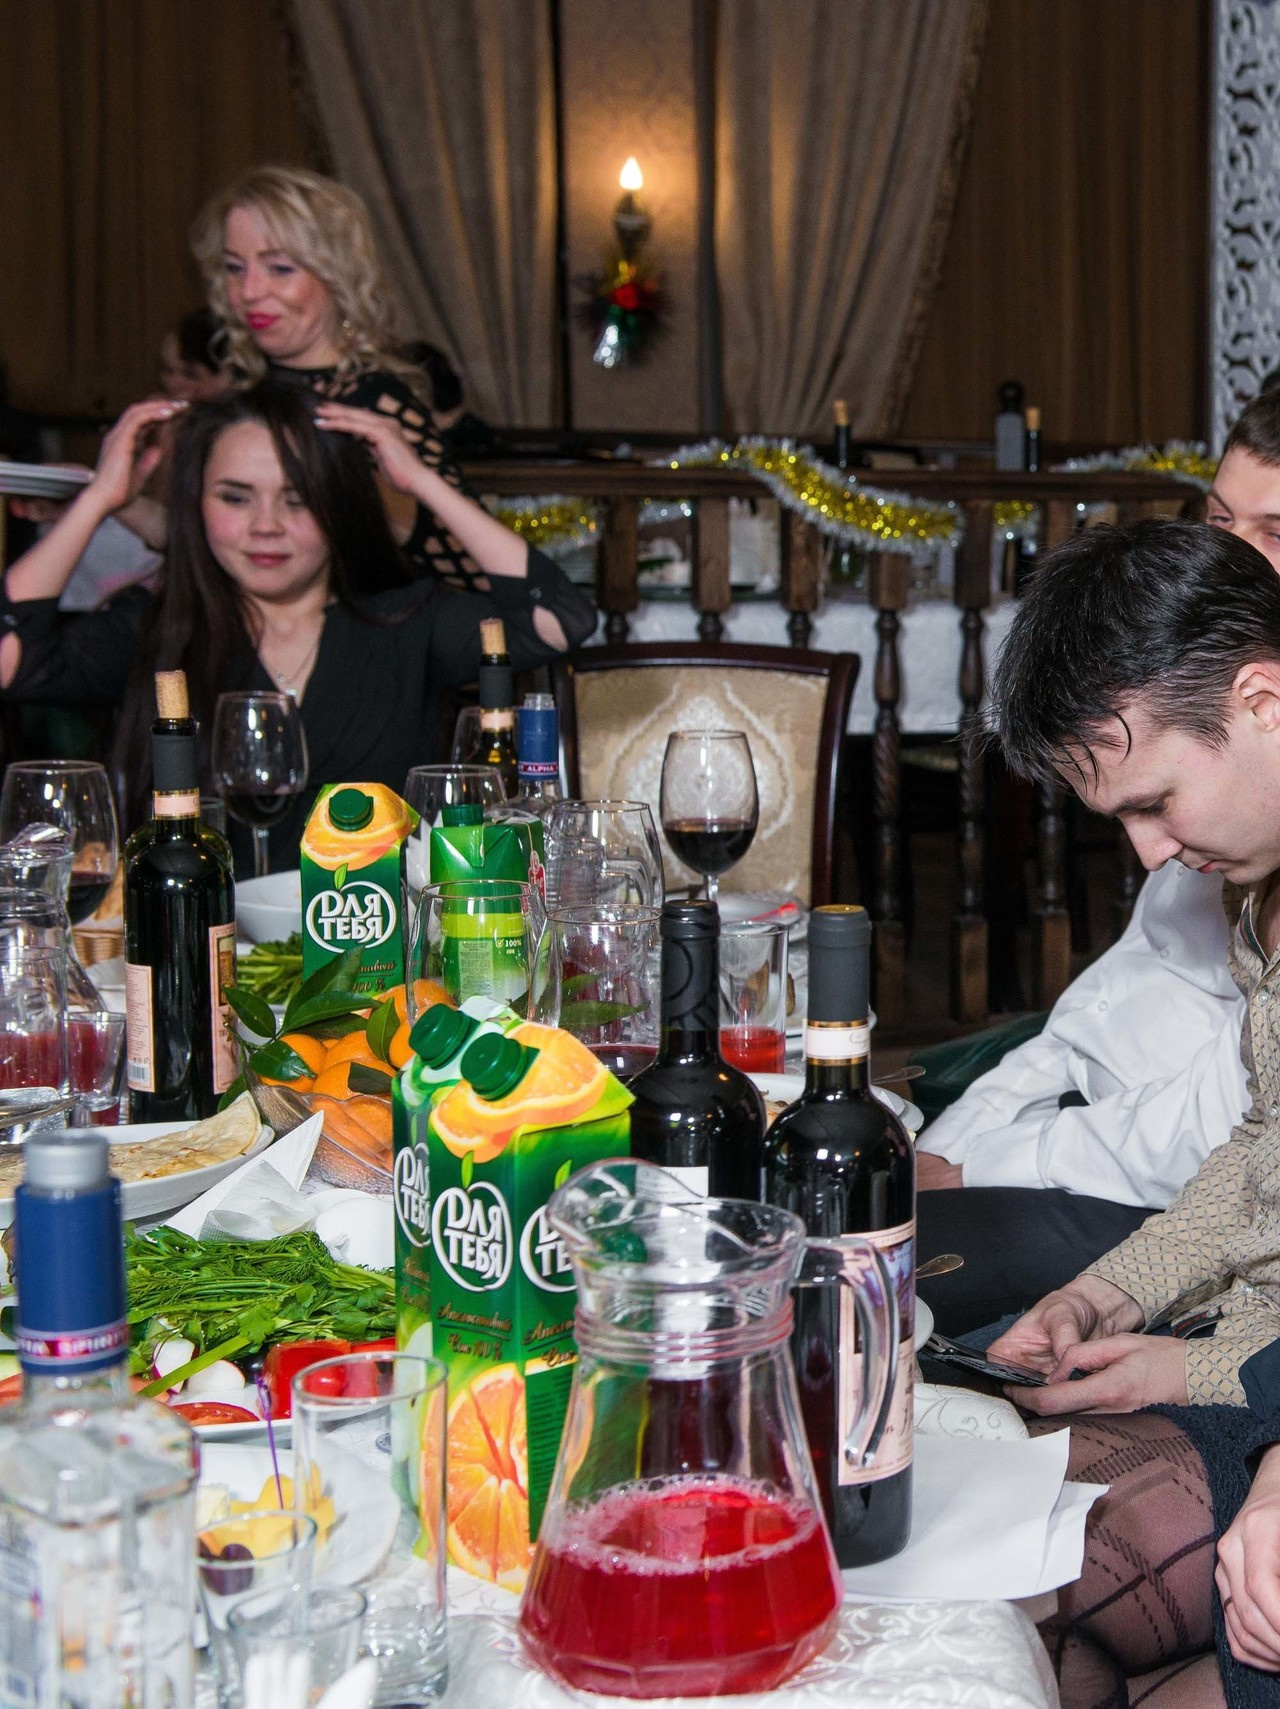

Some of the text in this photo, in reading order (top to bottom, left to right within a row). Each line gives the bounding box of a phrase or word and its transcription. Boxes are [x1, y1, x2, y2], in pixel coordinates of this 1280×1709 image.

[528, 764, 554, 772] ALPHA
[318, 917, 383, 943] ТЕБЯ
[443, 1226, 503, 1279] ТЕБЯ
[535, 1239, 575, 1277] ТЕ
